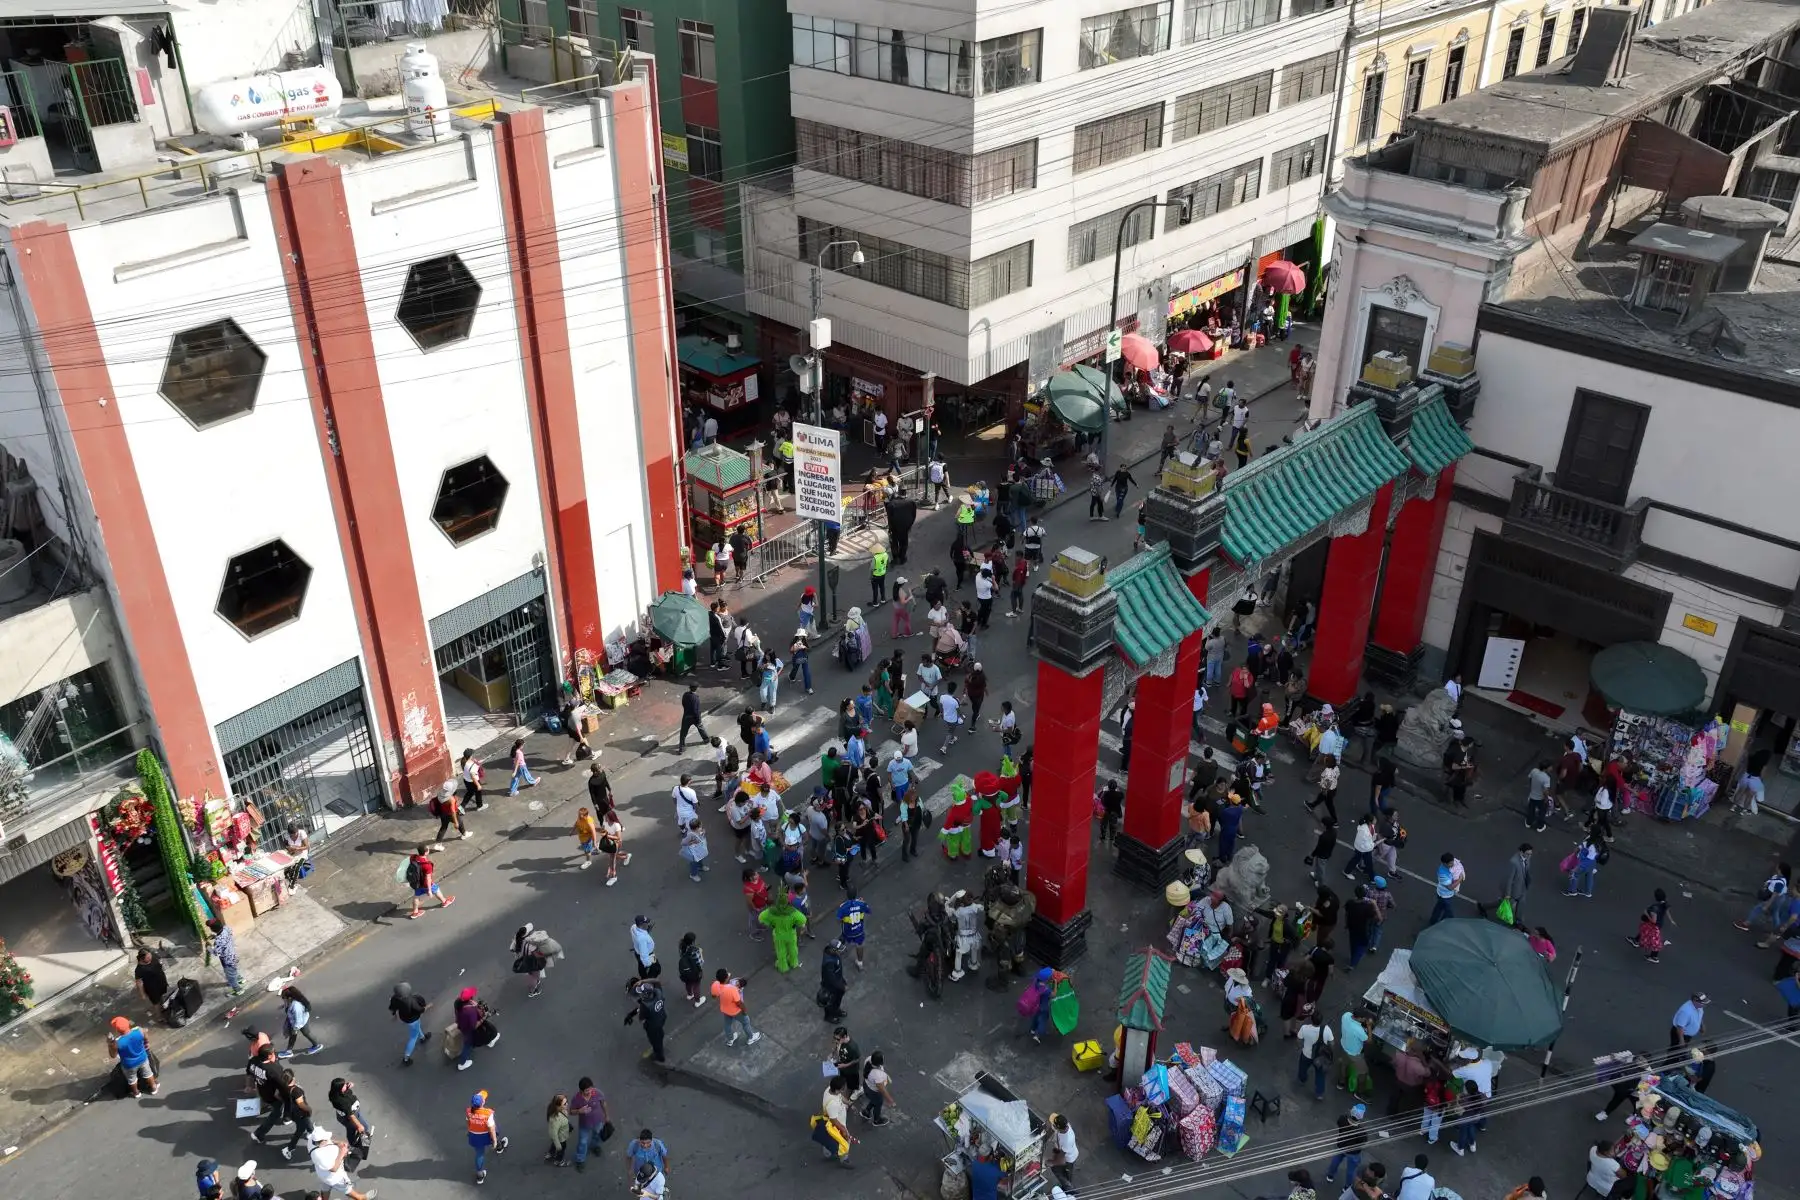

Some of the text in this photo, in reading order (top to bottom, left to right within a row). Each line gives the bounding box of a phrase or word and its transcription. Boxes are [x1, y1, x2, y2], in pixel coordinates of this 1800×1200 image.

[808, 436, 834, 448] LIMA
[816, 450, 836, 459] SEGURA
[805, 463, 827, 474] EVITA
[798, 470, 835, 483] INGRESAR
[803, 479, 837, 492] LUGARES
[801, 487, 833, 500] QUE HAN
[799, 494, 835, 508] EXCEDIDO
[800, 503, 836, 516] SU AFORO
